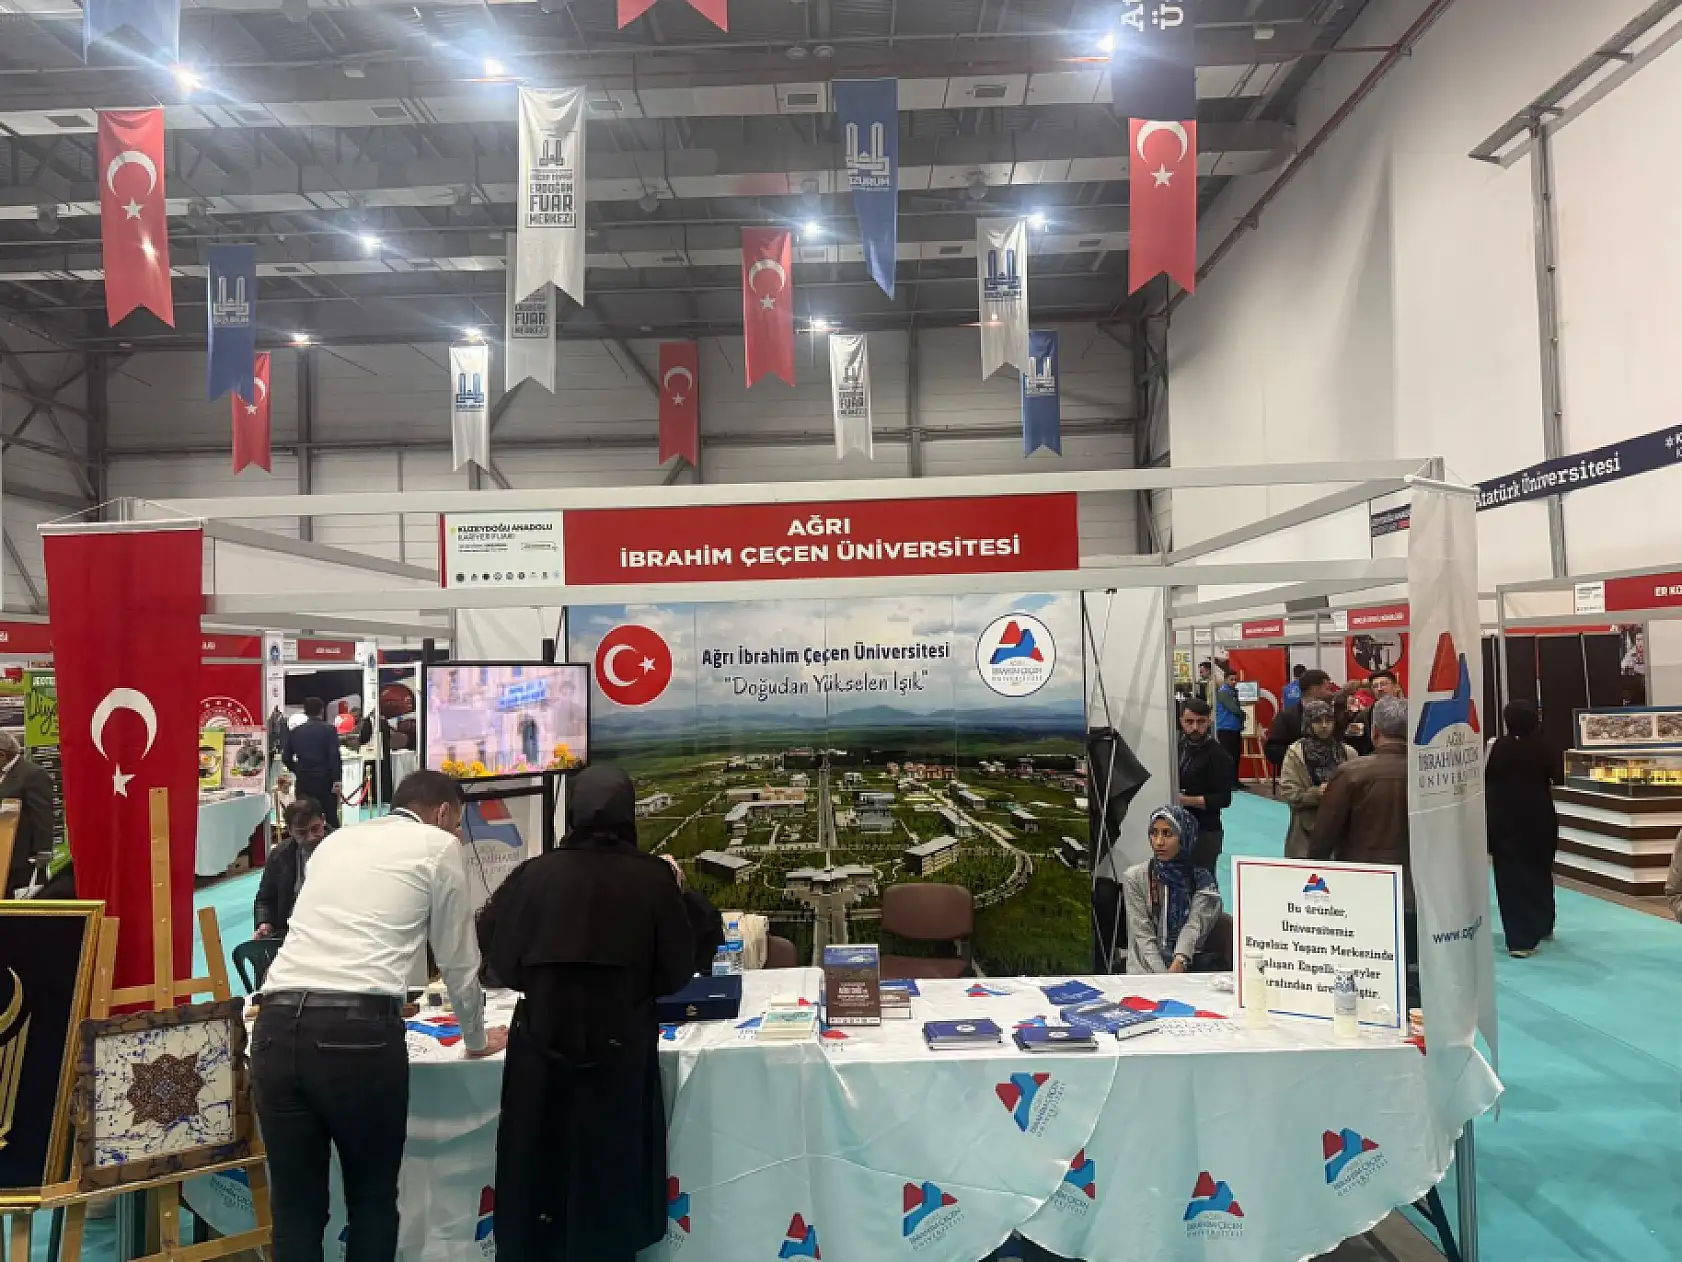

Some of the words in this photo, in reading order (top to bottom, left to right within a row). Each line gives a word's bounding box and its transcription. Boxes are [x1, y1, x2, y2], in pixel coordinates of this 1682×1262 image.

[529, 195, 573, 212] FUAR
[515, 312, 546, 325] FUAR
[1522, 452, 1621, 494] Üniversitesi
[512, 523, 552, 531] ANADOLU
[787, 514, 850, 536] AĞRI
[620, 546, 732, 568] İBRAHİM
[740, 544, 829, 567] ÇEÇEN
[836, 533, 1021, 561] ÜNİVERSİTESİ
[702, 648, 733, 668] Ağrı
[738, 645, 799, 665] İbrahim
[804, 647, 849, 666] Çeçen
[854, 641, 951, 660] Üniversitesi
[724, 676, 809, 702] "Doğudan
[813, 671, 888, 693] Yükselen
[893, 669, 929, 696] Işık"
[1287, 902, 1301, 913] Bu
[1304, 903, 1348, 918] ürünler,
[1281, 919, 1355, 937] Üniversitemiz
[1245, 935, 1289, 951] Engelsiz
[1292, 941, 1328, 955] Yaşam
[1330, 945, 1394, 961] Merkezinde
